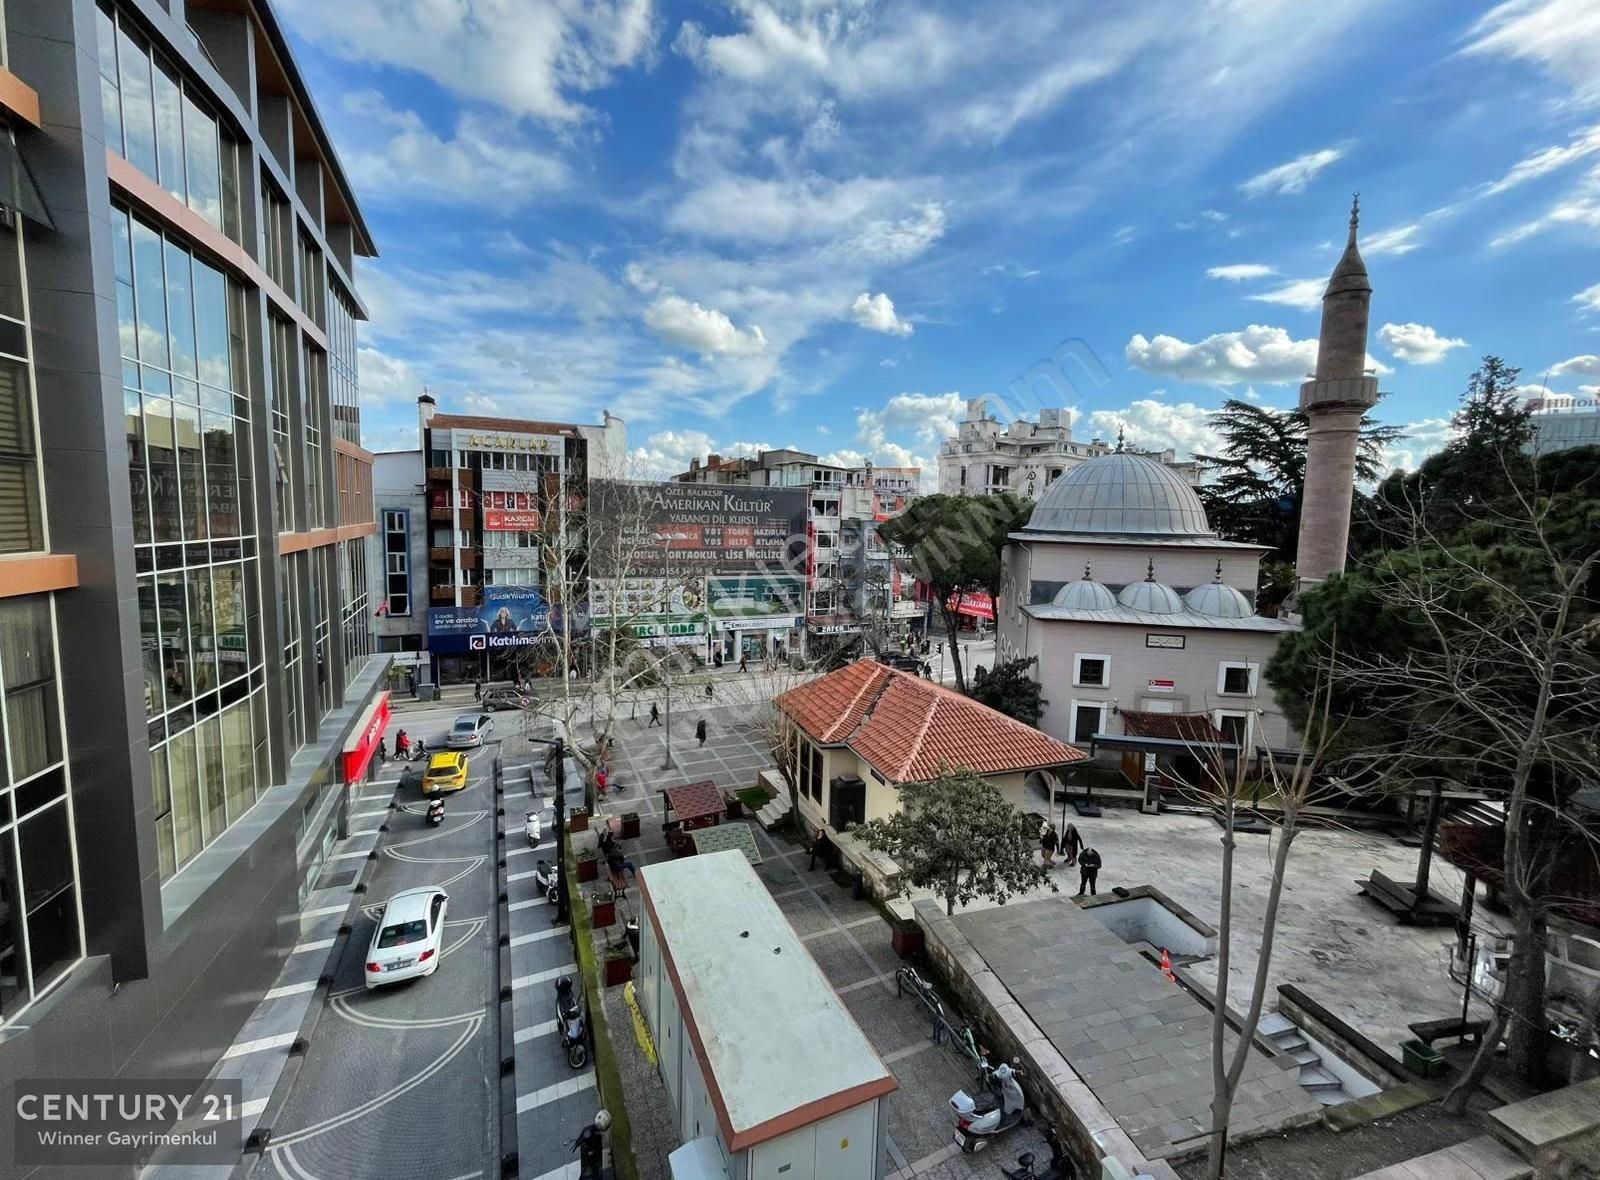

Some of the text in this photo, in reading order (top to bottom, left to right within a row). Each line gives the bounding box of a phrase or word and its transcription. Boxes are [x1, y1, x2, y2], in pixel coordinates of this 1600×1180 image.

[652, 492, 720, 511] AMERİKAN
[669, 513, 711, 524] YABANCI
[729, 515, 758, 524] KURSU
[668, 550, 718, 560] ORTAOKUL
[725, 549, 744, 560] LİSE
[745, 549, 785, 560] İNGİLİZCE
